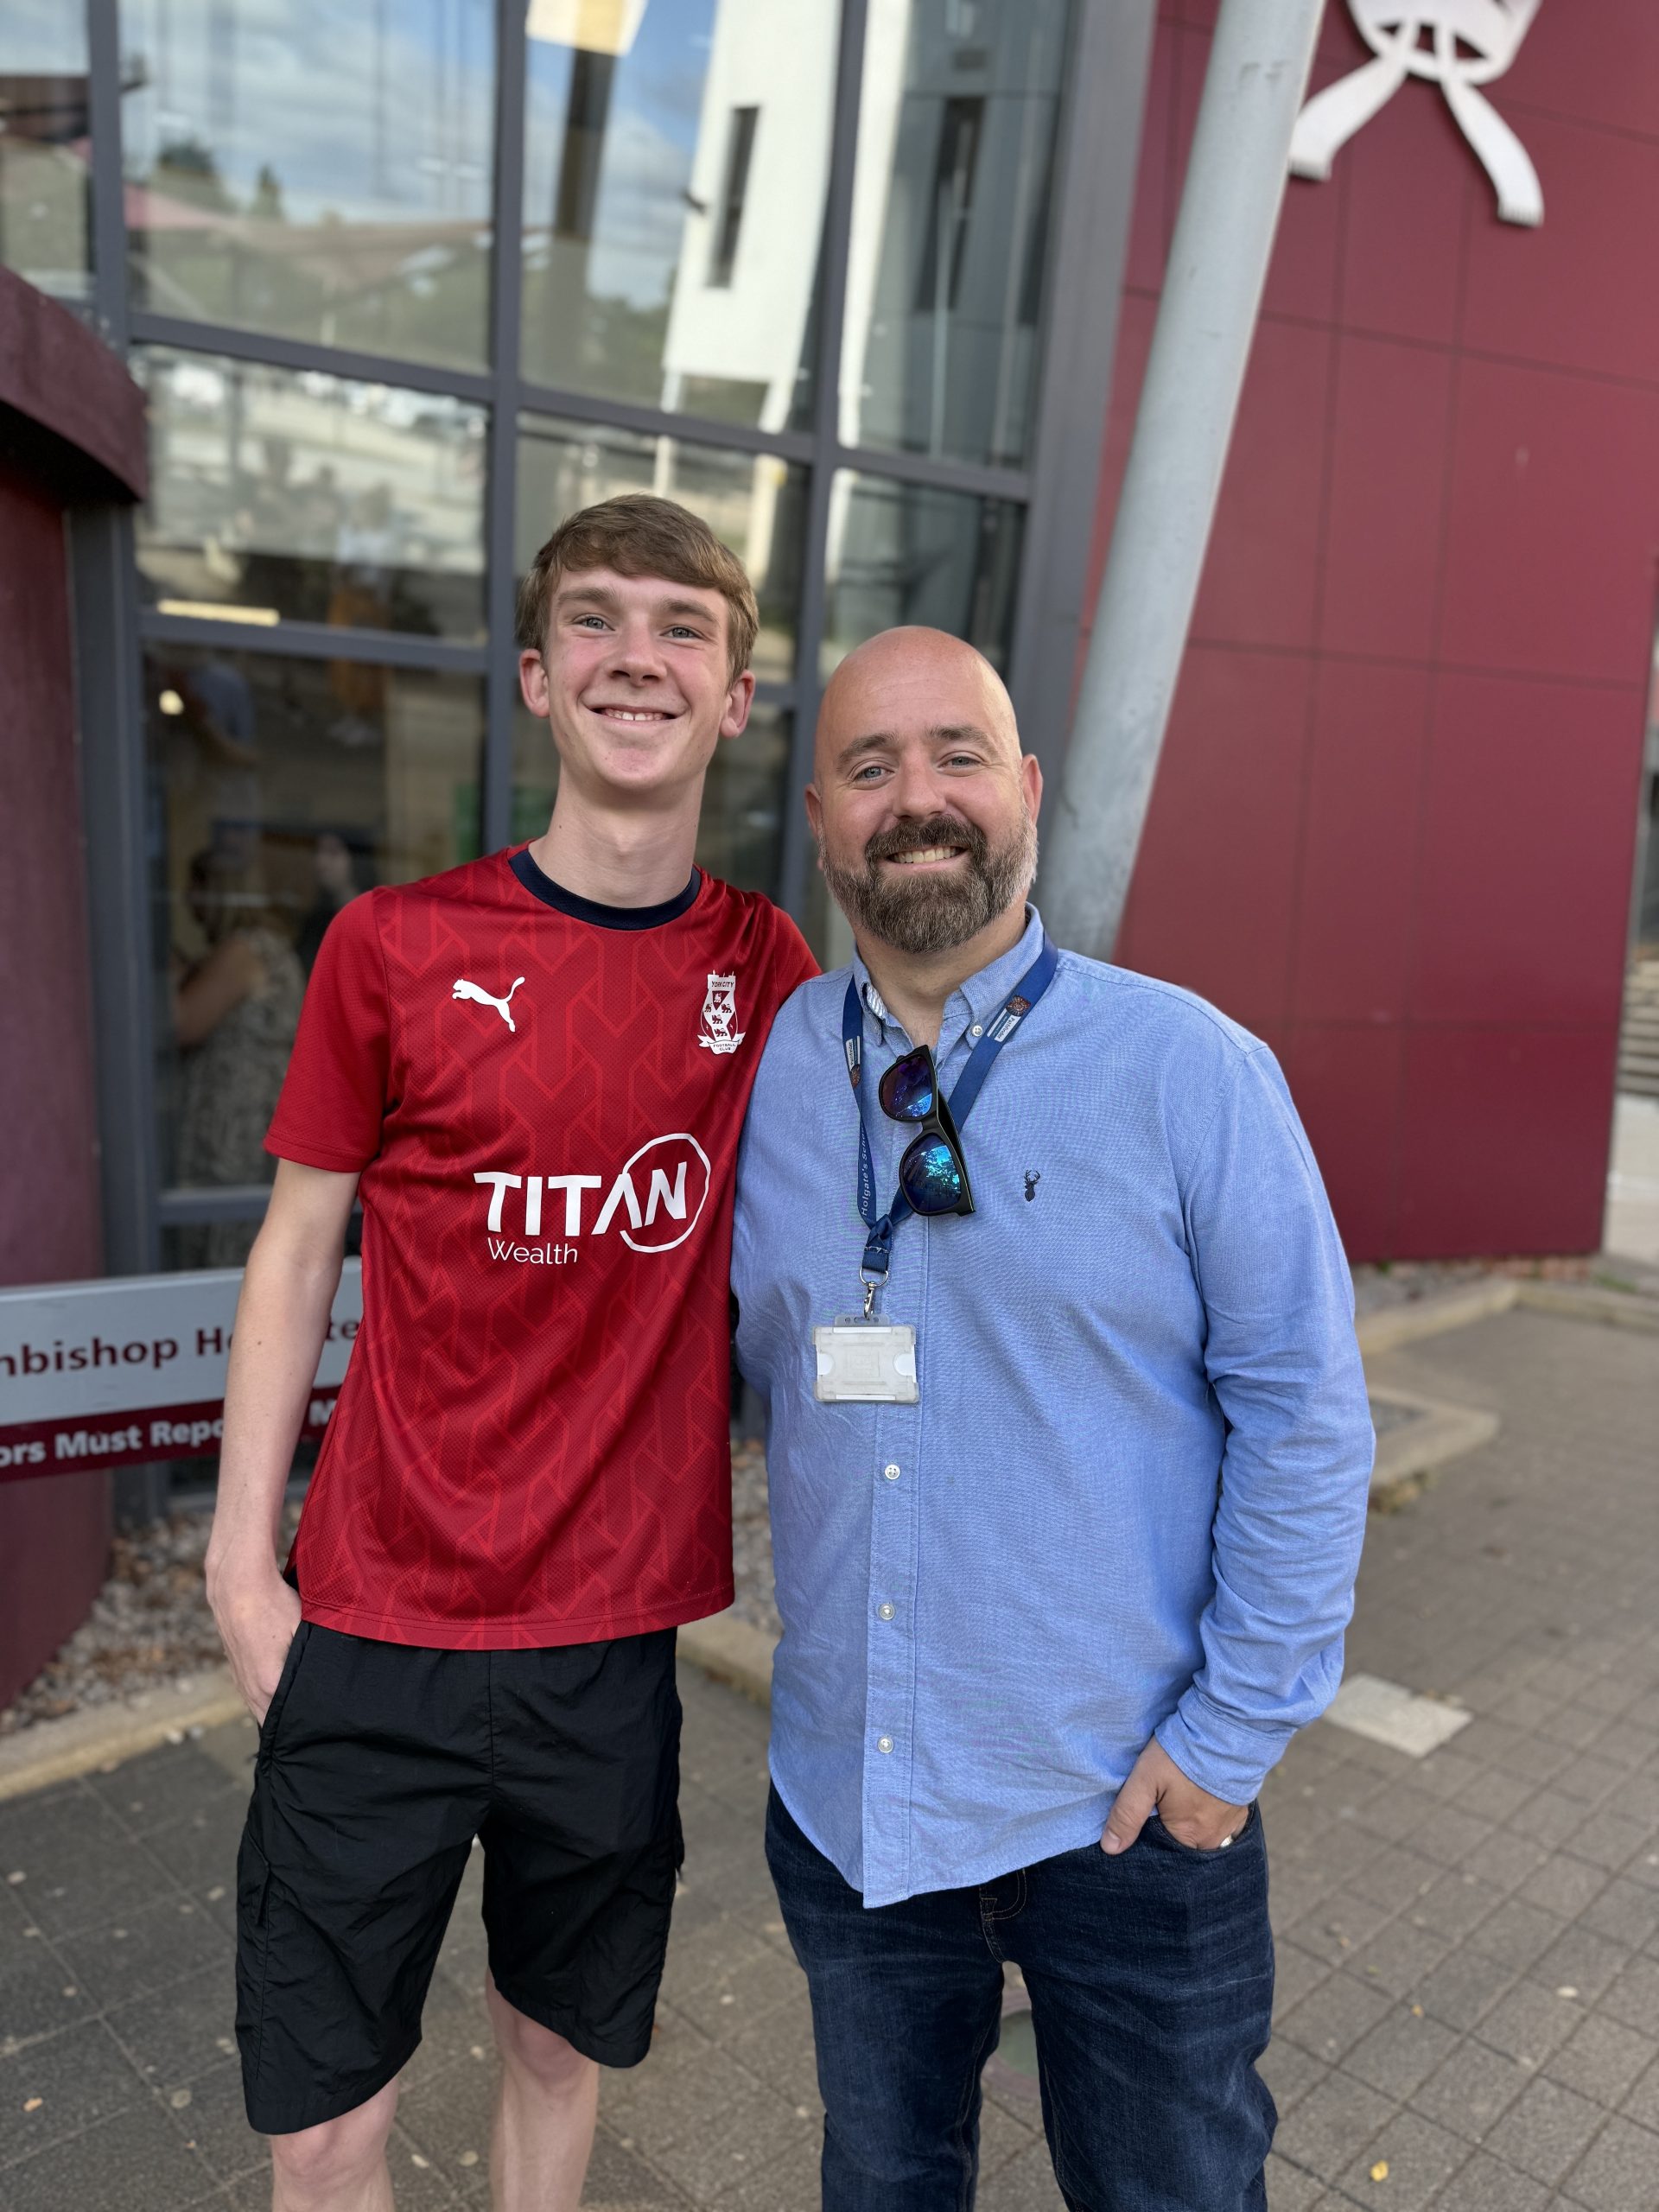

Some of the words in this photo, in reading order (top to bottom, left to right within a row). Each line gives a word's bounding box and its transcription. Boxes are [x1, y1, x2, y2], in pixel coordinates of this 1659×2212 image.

[474, 1161, 687, 1236] TITAN
[861, 1163, 871, 1217] Holgate's
[487, 1237, 578, 1264] Wealth
[54, 1424, 141, 1459] Must
